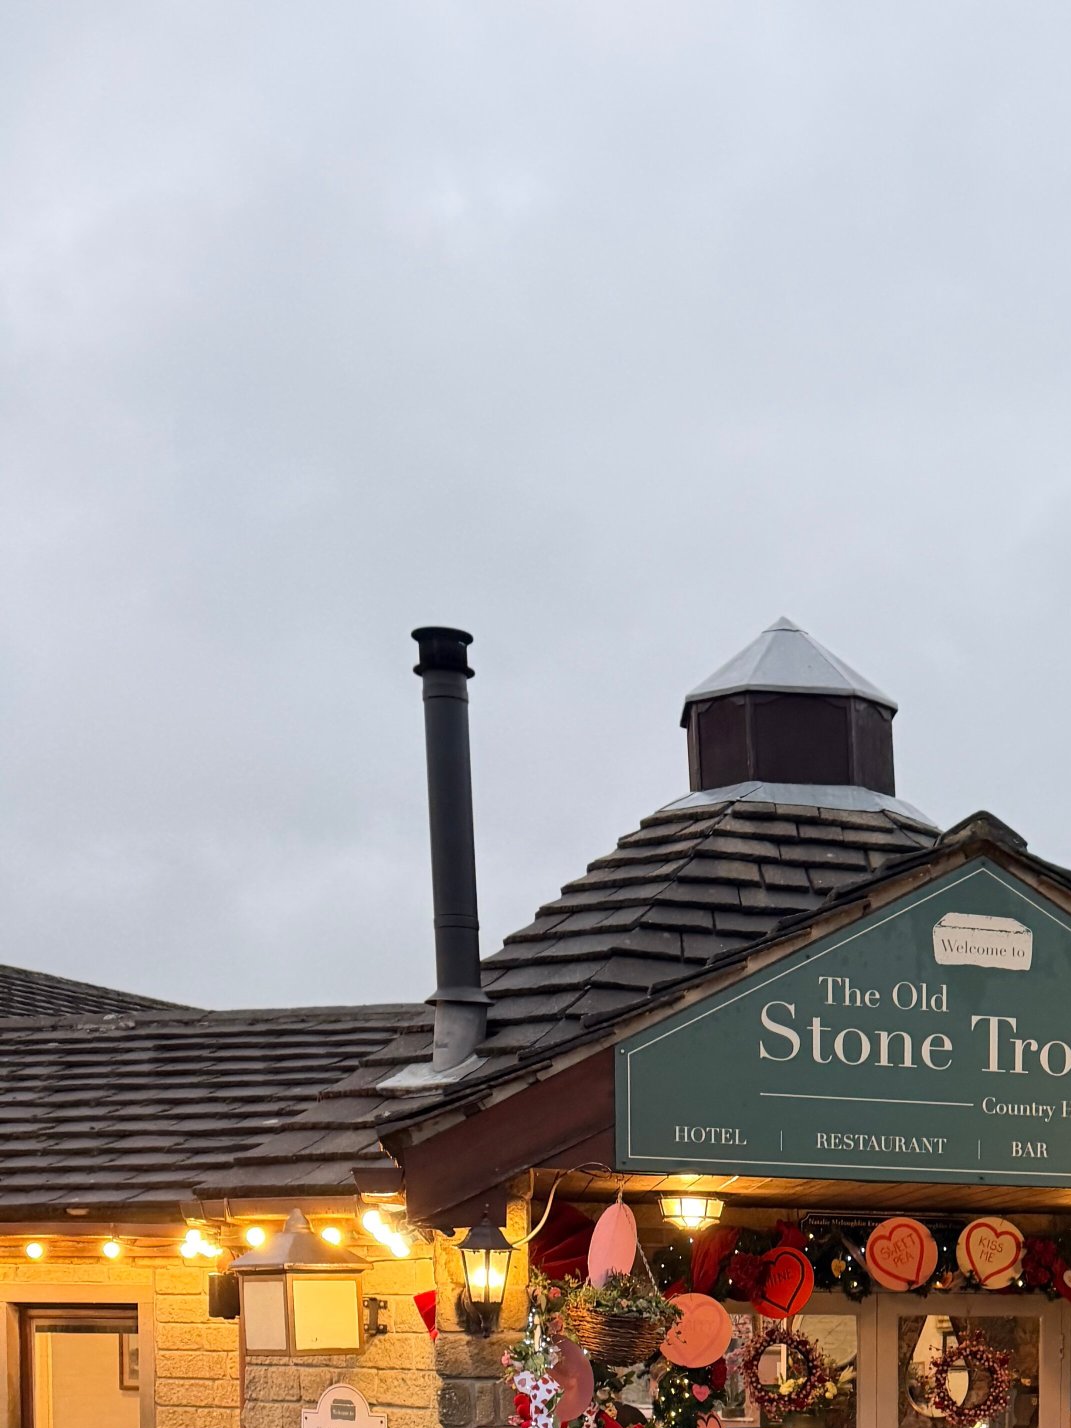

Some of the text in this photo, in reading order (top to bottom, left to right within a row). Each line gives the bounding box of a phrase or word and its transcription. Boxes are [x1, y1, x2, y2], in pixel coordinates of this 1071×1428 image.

[941, 938, 1026, 959] Welcome to
[818, 976, 949, 1012] The Old
[759, 1001, 953, 1070] Stone
[982, 1096, 1056, 1122] Country
[674, 1125, 747, 1145] HOTEL
[816, 1132, 948, 1154] RESTAURANT
[1011, 1141, 1049, 1158] BAR
[880, 1232, 917, 1259] SWEET
[978, 1235, 1003, 1252] KISS
[979, 1250, 996, 1263] ME
[893, 1251, 915, 1266] PEA
